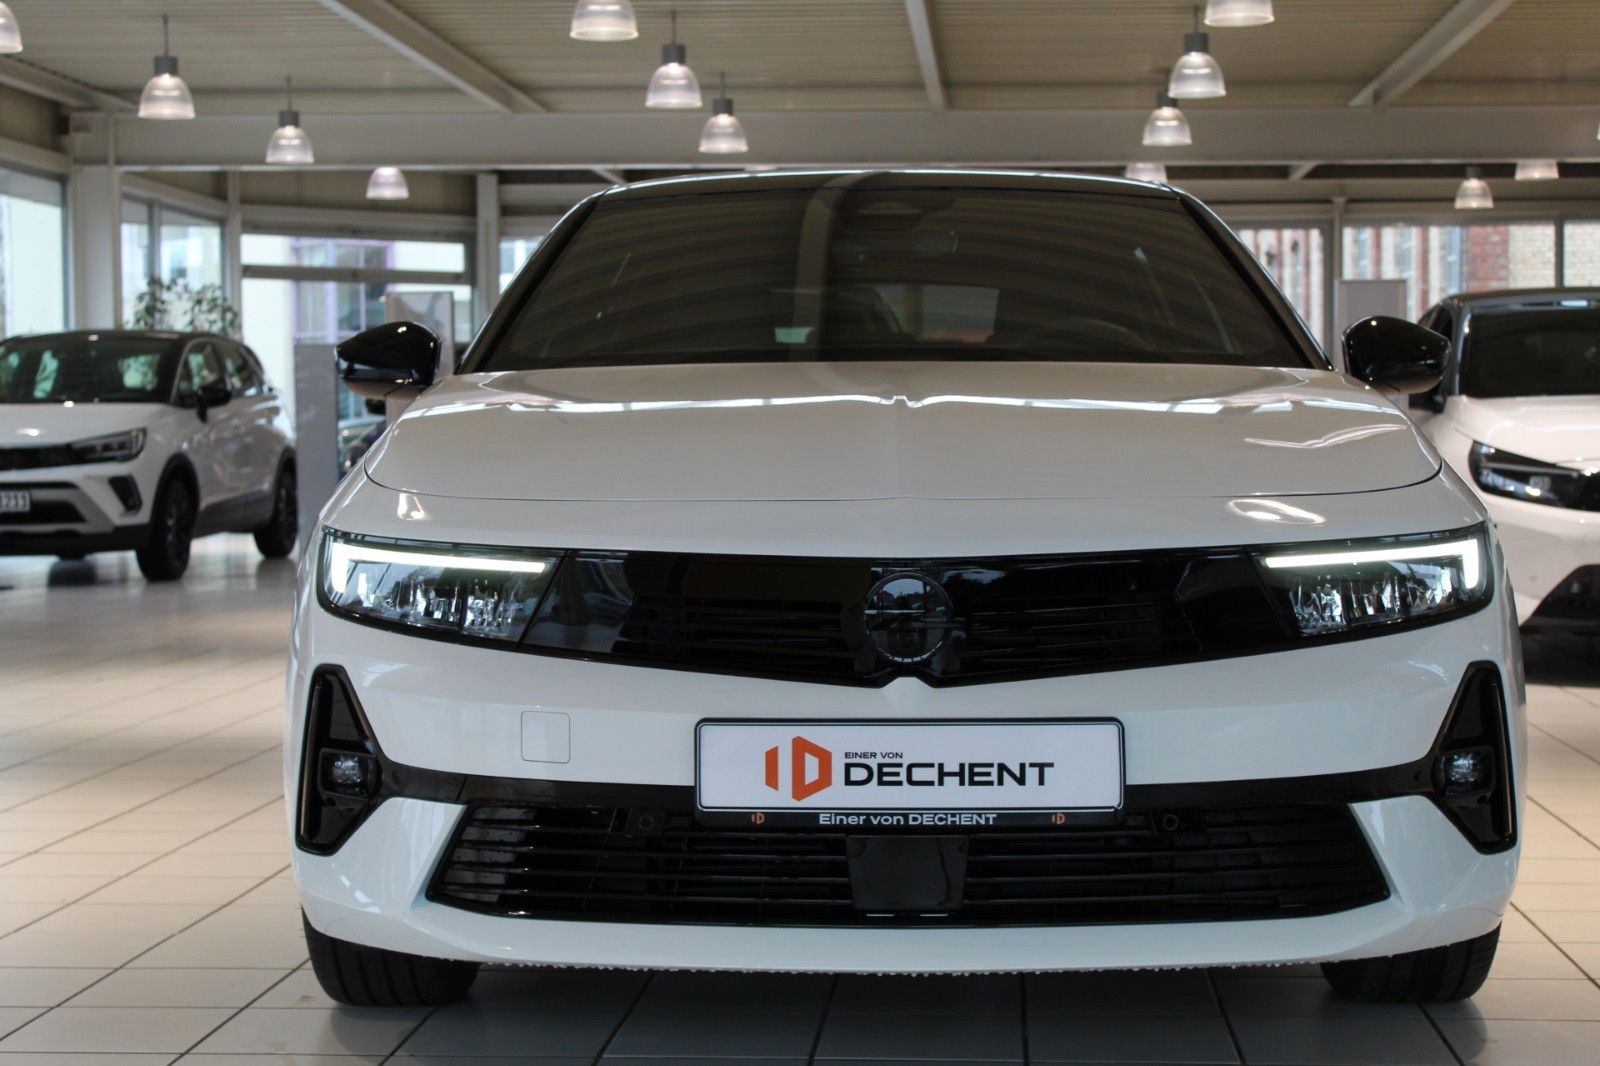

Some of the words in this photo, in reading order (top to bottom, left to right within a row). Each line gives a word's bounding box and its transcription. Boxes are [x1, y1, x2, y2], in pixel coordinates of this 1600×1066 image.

[844, 751, 878, 759] EINER
[880, 751, 904, 759] VON
[844, 762, 1055, 787] DECHENT
[818, 813, 867, 825] Einer
[870, 816, 905, 825] von
[908, 813, 998, 825] DECHENT
